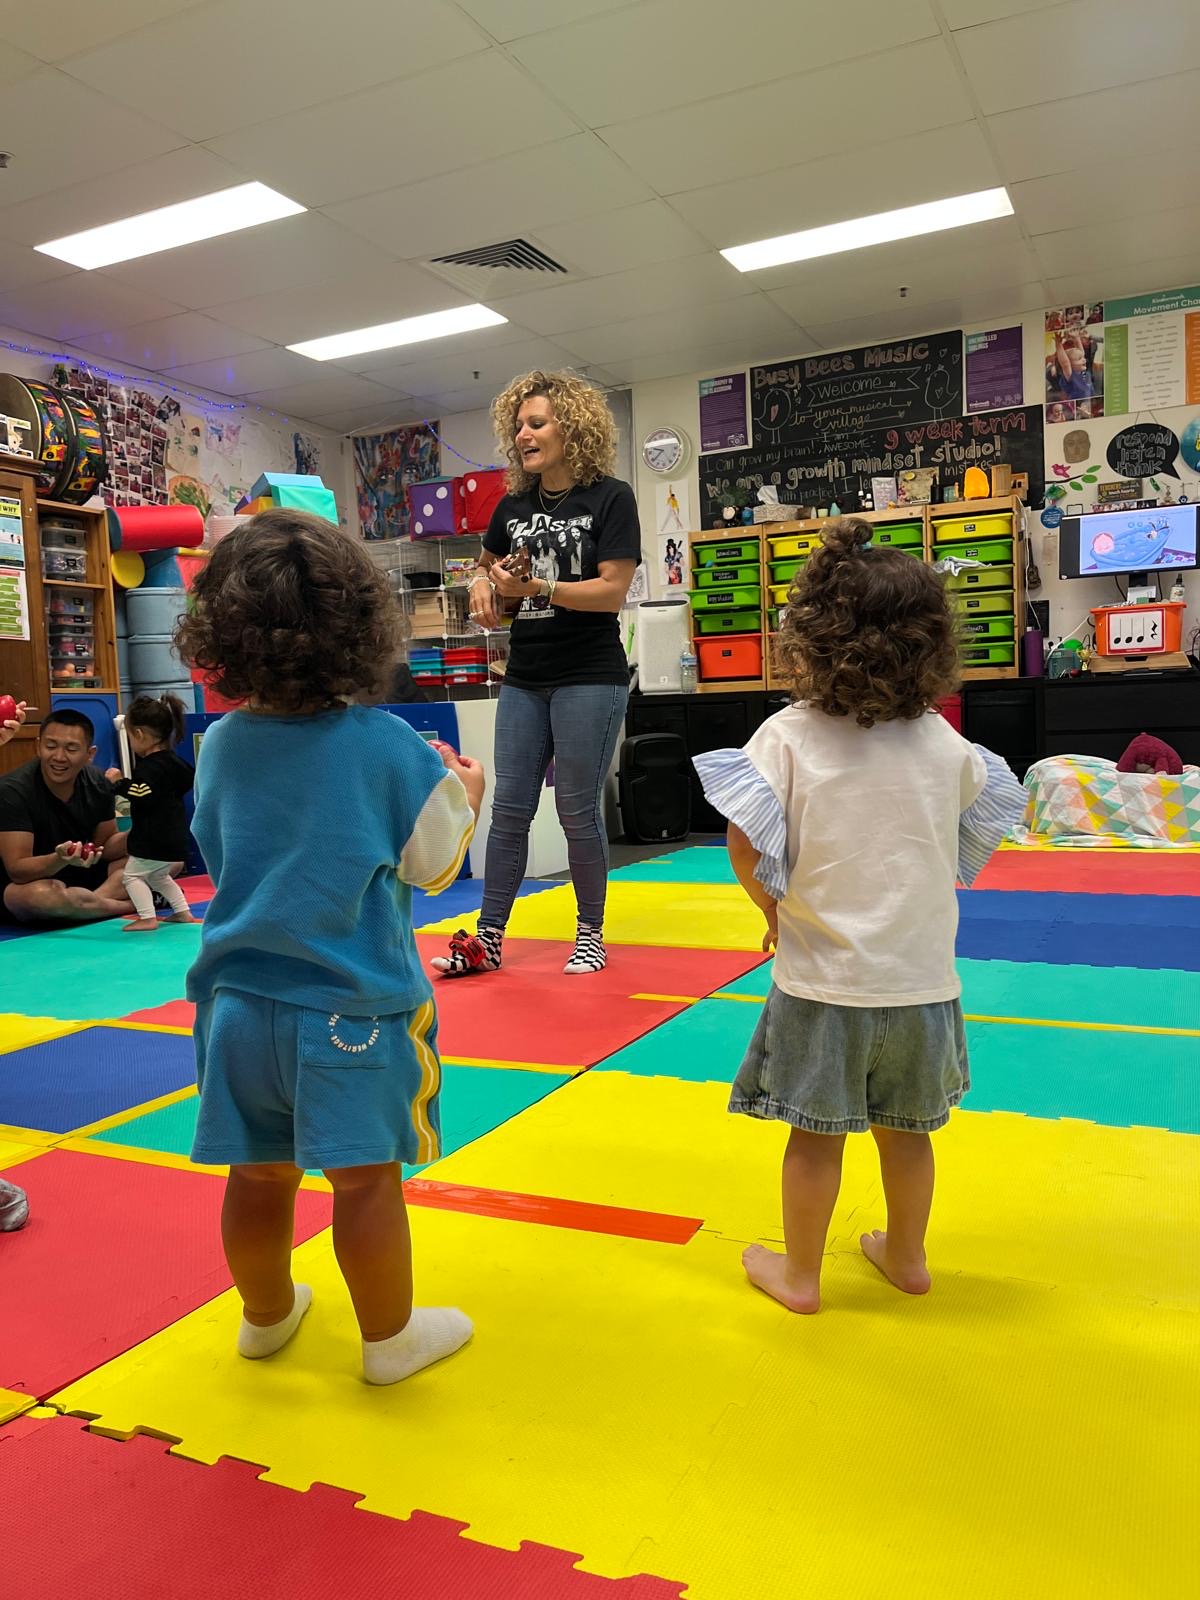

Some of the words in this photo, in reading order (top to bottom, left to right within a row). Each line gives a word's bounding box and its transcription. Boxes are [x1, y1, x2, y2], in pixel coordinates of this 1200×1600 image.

[1133, 301, 1179, 315] Movement
[1181, 298, 1200, 307] Cha
[754, 365, 801, 388] Busy
[805, 354, 855, 378] Bees
[863, 342, 929, 367] Music
[817, 376, 882, 398] Welcome
[813, 409, 848, 429] your
[849, 397, 894, 414] musical
[825, 413, 871, 431] village
[884, 429, 899, 450] 9
[905, 419, 964, 443] week
[968, 412, 1027, 437] term
[1115, 431, 1173, 449] respond
[824, 440, 872, 453] AWESOME
[1120, 444, 1165, 464] listen
[715, 459, 735, 472] can
[738, 456, 763, 473] grow
[766, 451, 781, 465] my
[736, 473, 764, 489] are
[771, 471, 781, 485] a
[786, 457, 846, 490] growth
[852, 445, 924, 473] mindset
[931, 435, 1001, 463] studio!
[1114, 460, 1163, 477] think
[330, 1035, 368, 1053] HERITAGE
